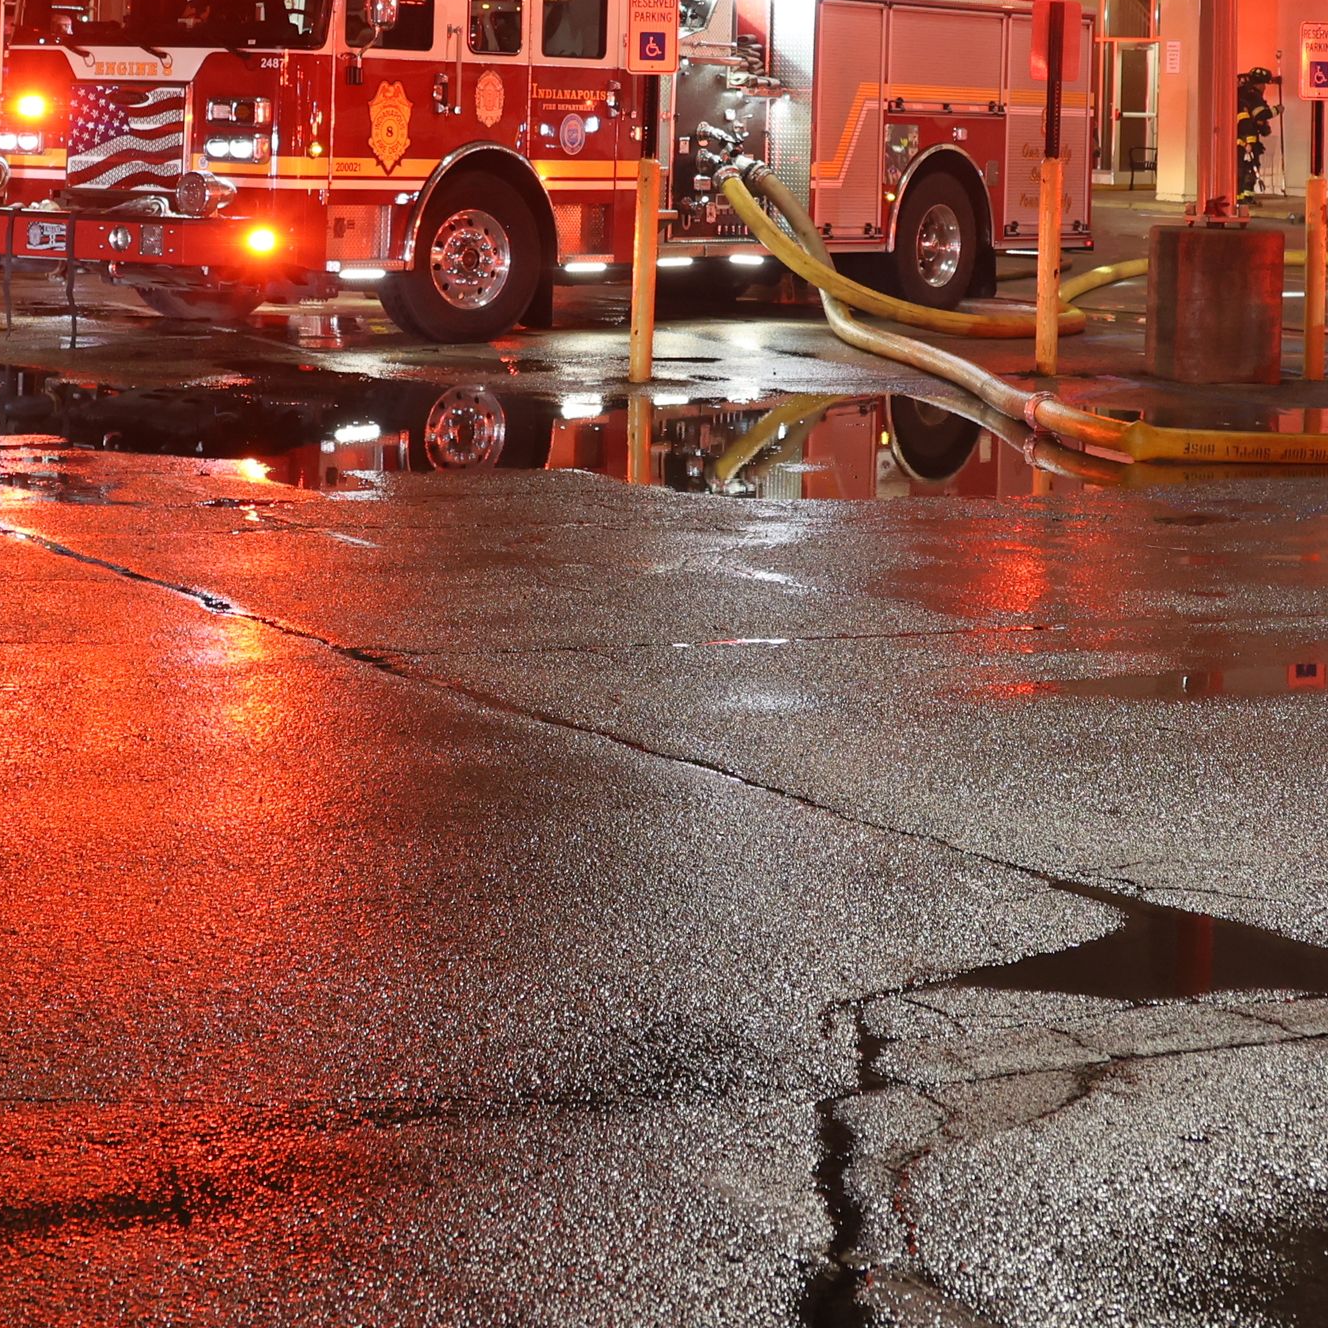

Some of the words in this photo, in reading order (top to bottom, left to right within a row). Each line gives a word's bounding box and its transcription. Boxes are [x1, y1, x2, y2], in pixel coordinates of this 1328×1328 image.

[634, 11, 672, 23] PARKING
[95, 61, 158, 76] ENGINE
[260, 57, 285, 69] 2487
[532, 83, 607, 101] INDIANAPOLIS
[385, 126, 394, 137] 8
[335, 162, 362, 173] 200021
